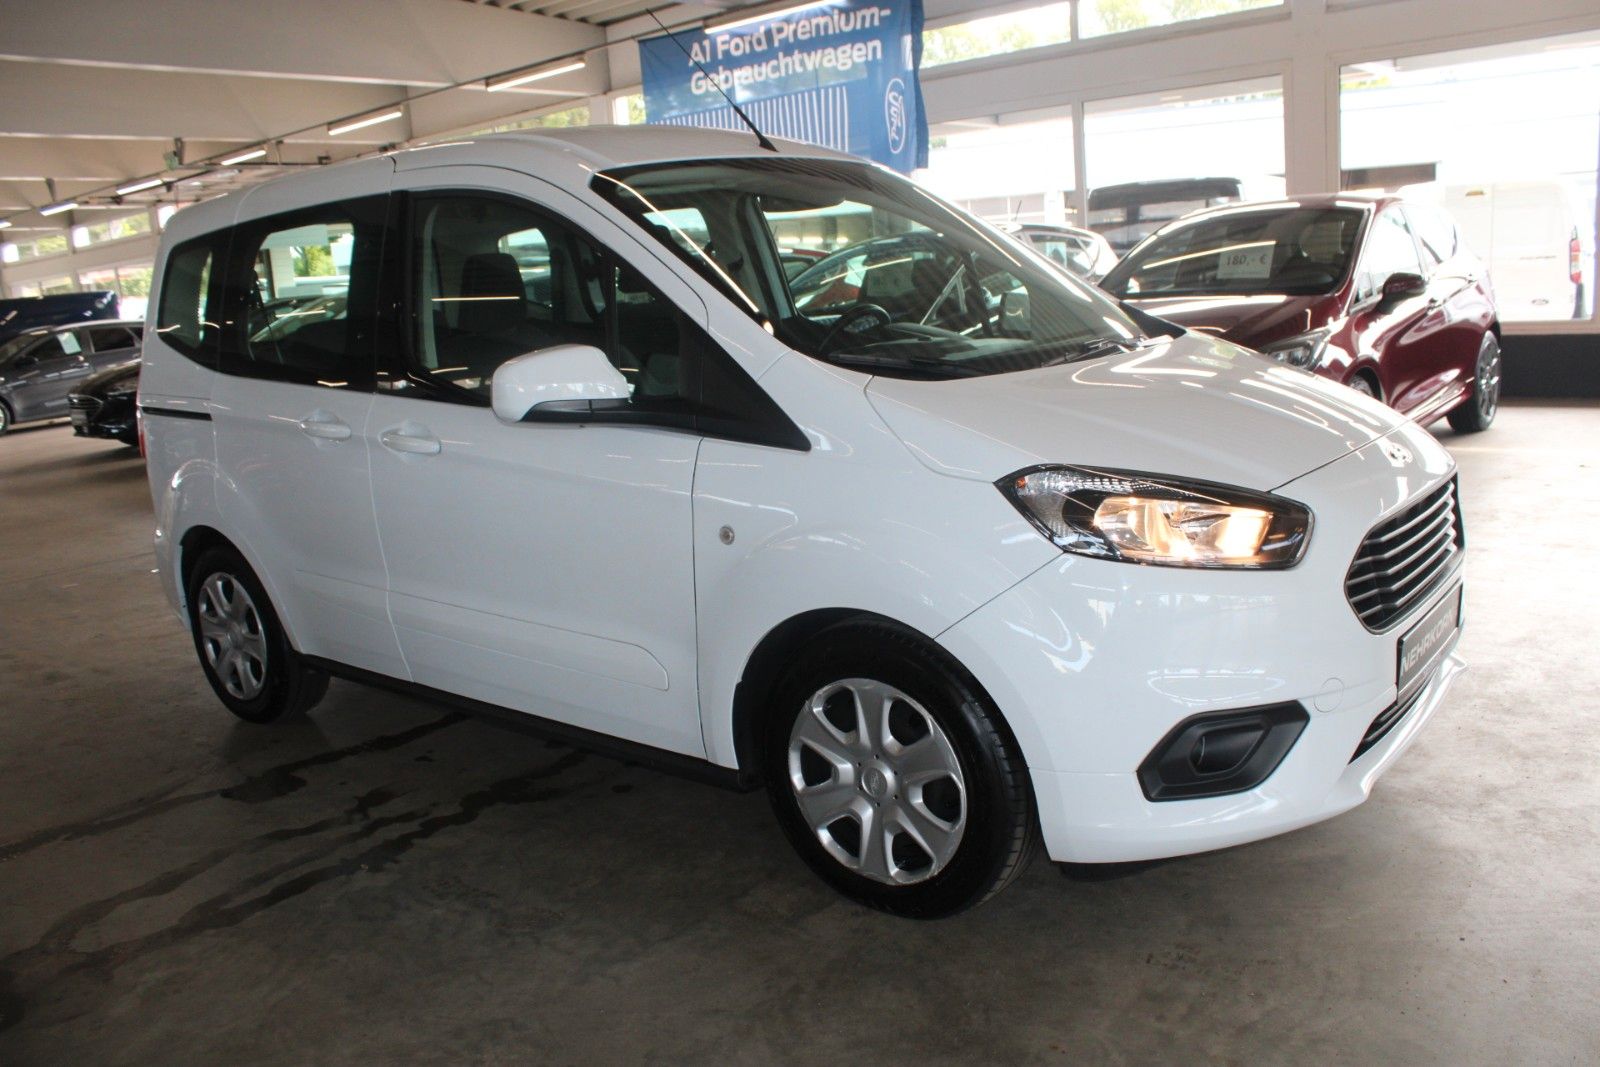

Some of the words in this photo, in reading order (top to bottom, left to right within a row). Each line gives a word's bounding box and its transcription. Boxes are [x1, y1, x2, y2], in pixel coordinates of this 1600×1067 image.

[688, 40, 711, 67] A1
[716, 28, 767, 58] Ford
[772, 7, 892, 48] Premium-
[690, 39, 881, 95] Gebrauchtwagen
